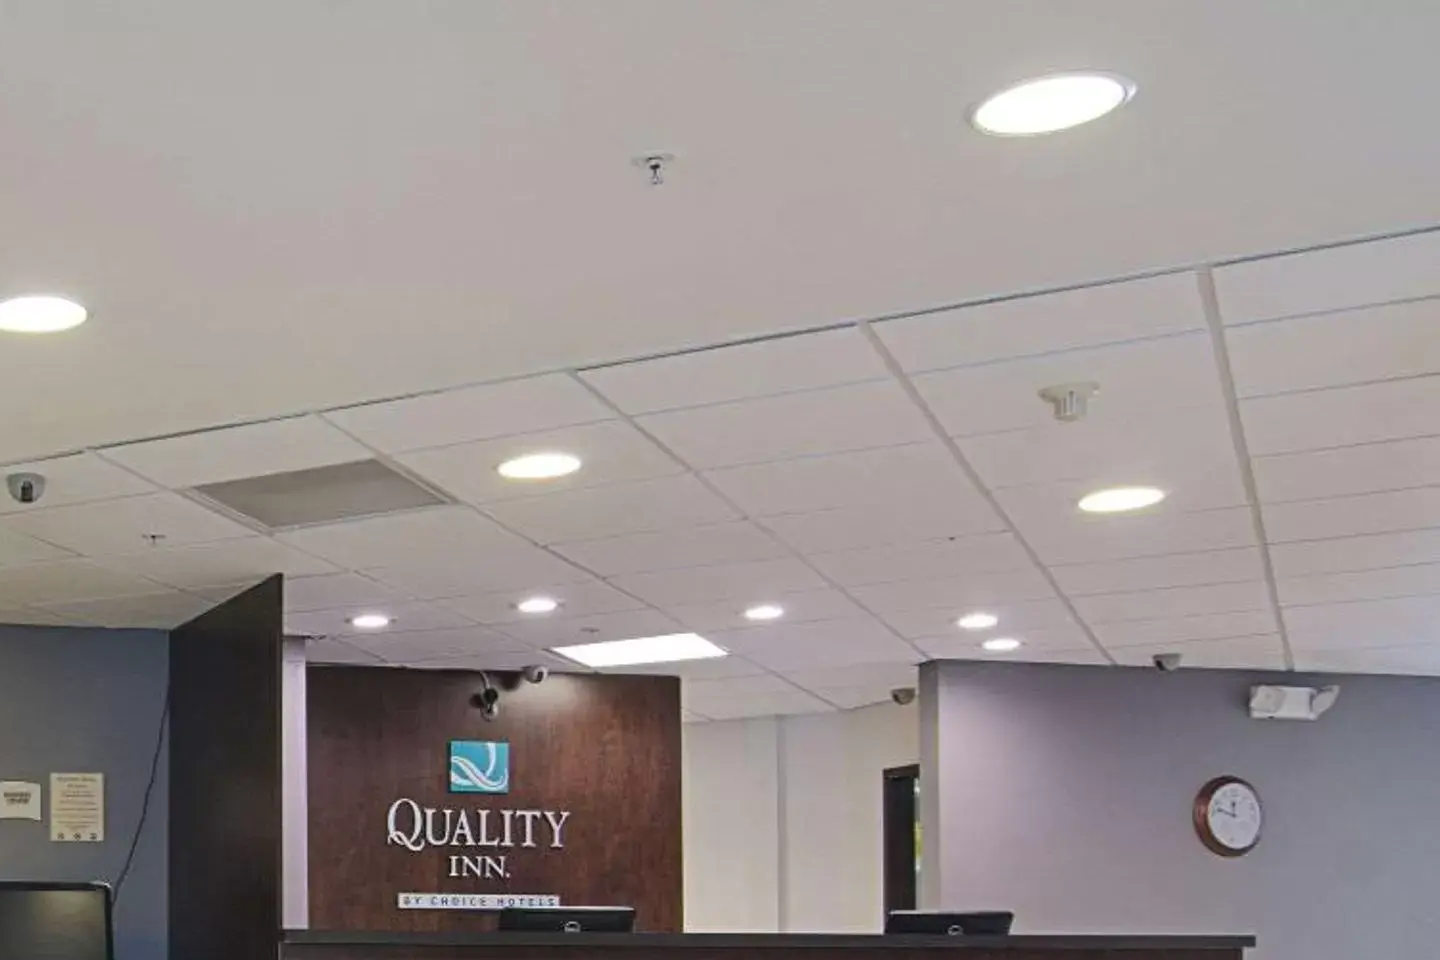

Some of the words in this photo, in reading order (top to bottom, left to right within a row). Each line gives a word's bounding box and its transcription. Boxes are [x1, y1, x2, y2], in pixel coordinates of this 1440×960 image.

[387, 798, 570, 851] QUALITY
[402, 895, 421, 907] BY
[431, 895, 488, 907] CHOICE
[496, 895, 556, 908] HOTELS
